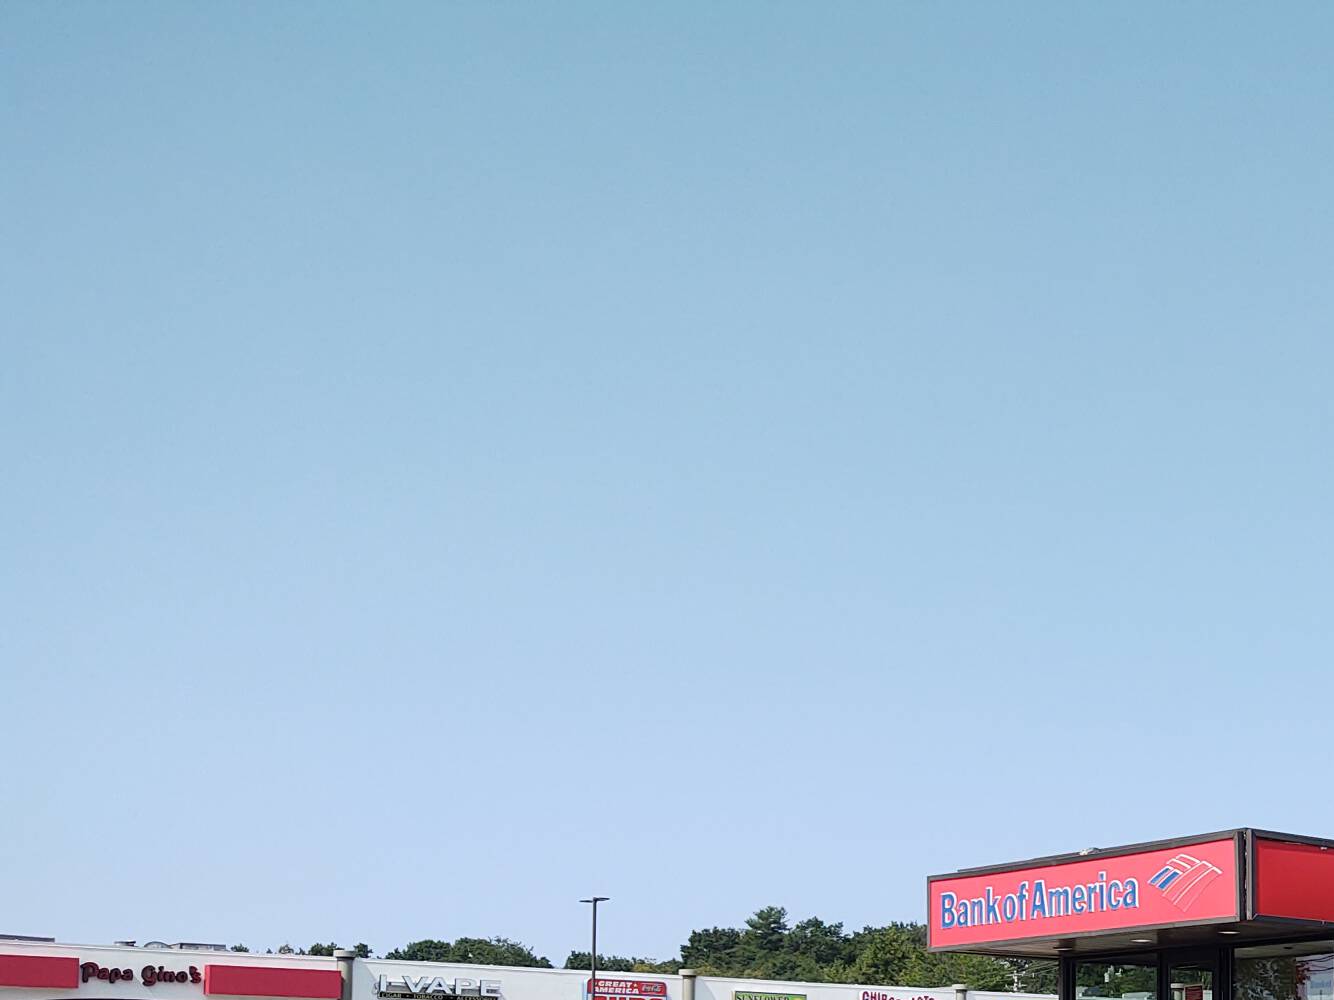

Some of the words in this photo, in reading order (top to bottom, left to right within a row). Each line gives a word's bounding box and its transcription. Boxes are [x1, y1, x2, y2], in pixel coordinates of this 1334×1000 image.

[940, 887, 1002, 929] Bank
[1003, 880, 1029, 922] of
[1030, 871, 1140, 921] America
[80, 961, 134, 984] Papa
[141, 965, 202, 987] Gino's
[598, 980, 633, 988] GREAT
[402, 975, 502, 997] VAPE
[594, 986, 640, 994] AMERICA
